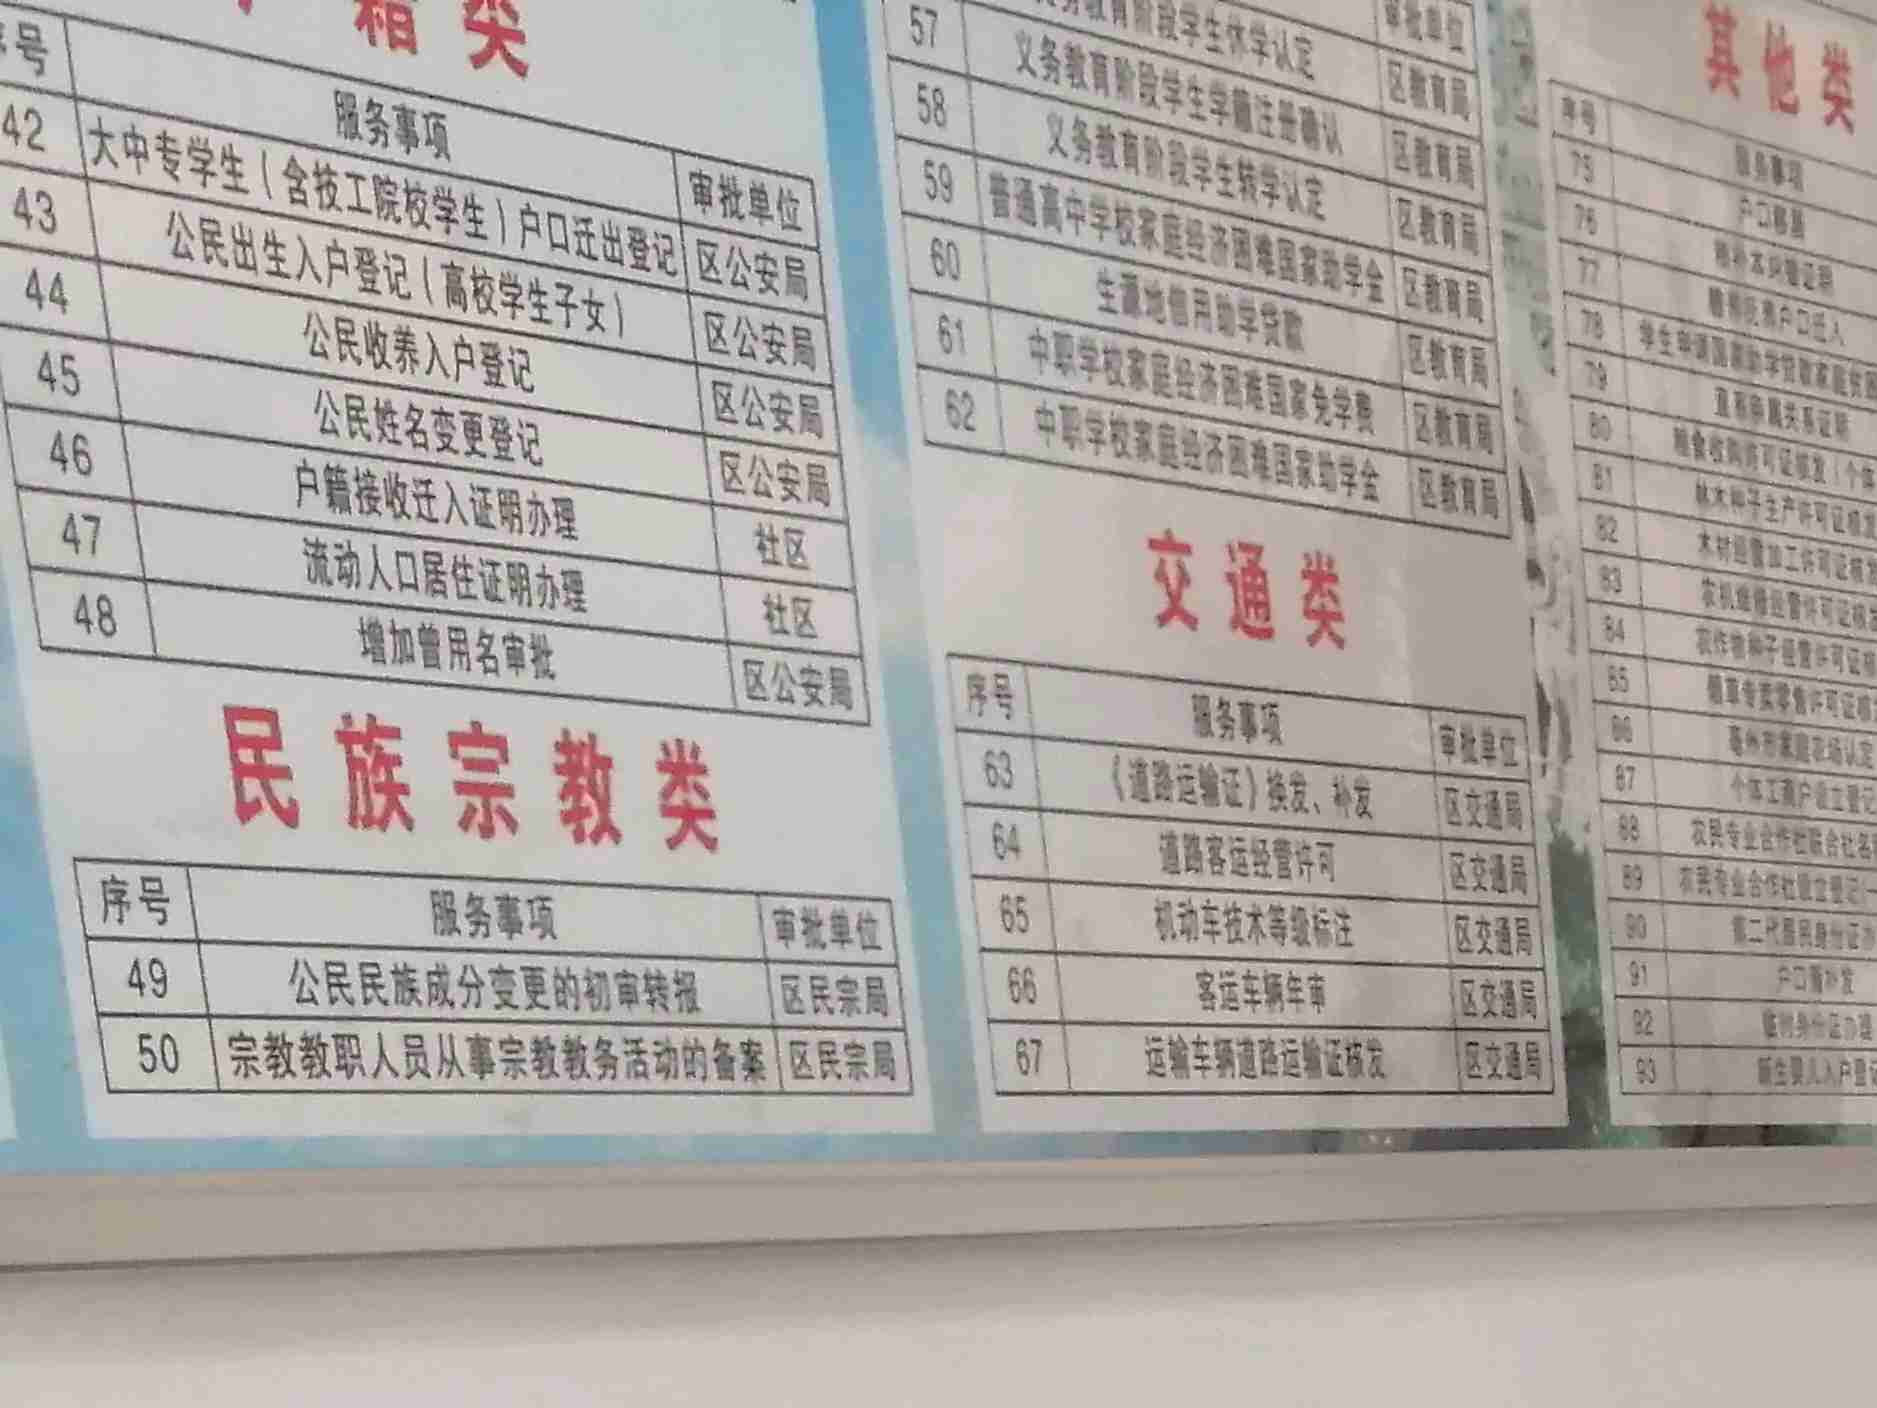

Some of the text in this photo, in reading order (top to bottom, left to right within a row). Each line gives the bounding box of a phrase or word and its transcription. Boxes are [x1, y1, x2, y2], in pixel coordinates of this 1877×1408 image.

[907, 2, 940, 51] 57
[1704, 4, 1854, 135] 其他类
[334, 90, 451, 161] 服务事项
[913, 81, 948, 130] 58
[2, 105, 46, 153] 42
[688, 170, 808, 233] 审批单位
[921, 158, 955, 206] 59
[13, 188, 59, 230] 43
[697, 240, 810, 300] 区公安局
[928, 236, 962, 282] 60
[25, 270, 70, 313] 44
[304, 312, 535, 395] 公民收养入户登记
[705, 312, 817, 371] 区公安局
[936, 312, 968, 356] 61
[37, 352, 81, 396] 45
[313, 389, 545, 469] 公民姓名变更登记
[712, 381, 825, 438] 区公安局
[943, 388, 977, 433] 62
[50, 432, 94, 476] 46
[294, 461, 578, 541] 户籍接收迁入证明办理
[721, 450, 831, 508] 区公安局
[61, 513, 103, 557] 47
[755, 523, 809, 567] 社区
[1593, 512, 1618, 545] 82
[302, 535, 589, 614] 流动人口居住证明办理
[1146, 528, 1346, 650] 交通类
[72, 593, 118, 637] 48
[764, 595, 819, 640] 社区
[1601, 612, 1625, 644] 84
[359, 615, 558, 683] 增加曾用名审批
[743, 658, 855, 712] 区公安局
[965, 671, 1016, 720] 序号
[1190, 694, 1283, 744] 服务事项
[1438, 722, 1518, 768] 审批单位
[222, 703, 721, 855] 民族宗教类
[982, 749, 1015, 790] 63
[1613, 764, 1636, 793] 87
[1442, 786, 1522, 831] 区交通局
[991, 821, 1021, 860] 64
[1157, 830, 1337, 883] 道路客运经营许可
[1448, 850, 1527, 893] 区交通局
[1620, 862, 1643, 890] 89
[97, 873, 172, 928] 序号
[430, 889, 558, 944] 服务事项
[998, 894, 1030, 933] 65
[771, 905, 884, 953] 审批单位
[1453, 914, 1532, 955] 区交通局
[1624, 913, 1647, 939] 90
[127, 948, 170, 999] 49
[289, 956, 704, 1017] 公民民族成分变更的初审转报
[780, 973, 890, 1020] 区民宗局
[1006, 966, 1038, 1003] 66
[1195, 969, 1328, 1014] 客运车辆年审
[1628, 961, 1649, 988] 91
[1459, 978, 1537, 1019] 区交通局
[1631, 1009, 1653, 1036] 92
[138, 1030, 181, 1076] 50
[789, 1038, 898, 1083] 区民宗局
[1014, 1037, 1045, 1075] 67
[1464, 1041, 1543, 1080] 区交通局
[1634, 1058, 1657, 1084] 93
